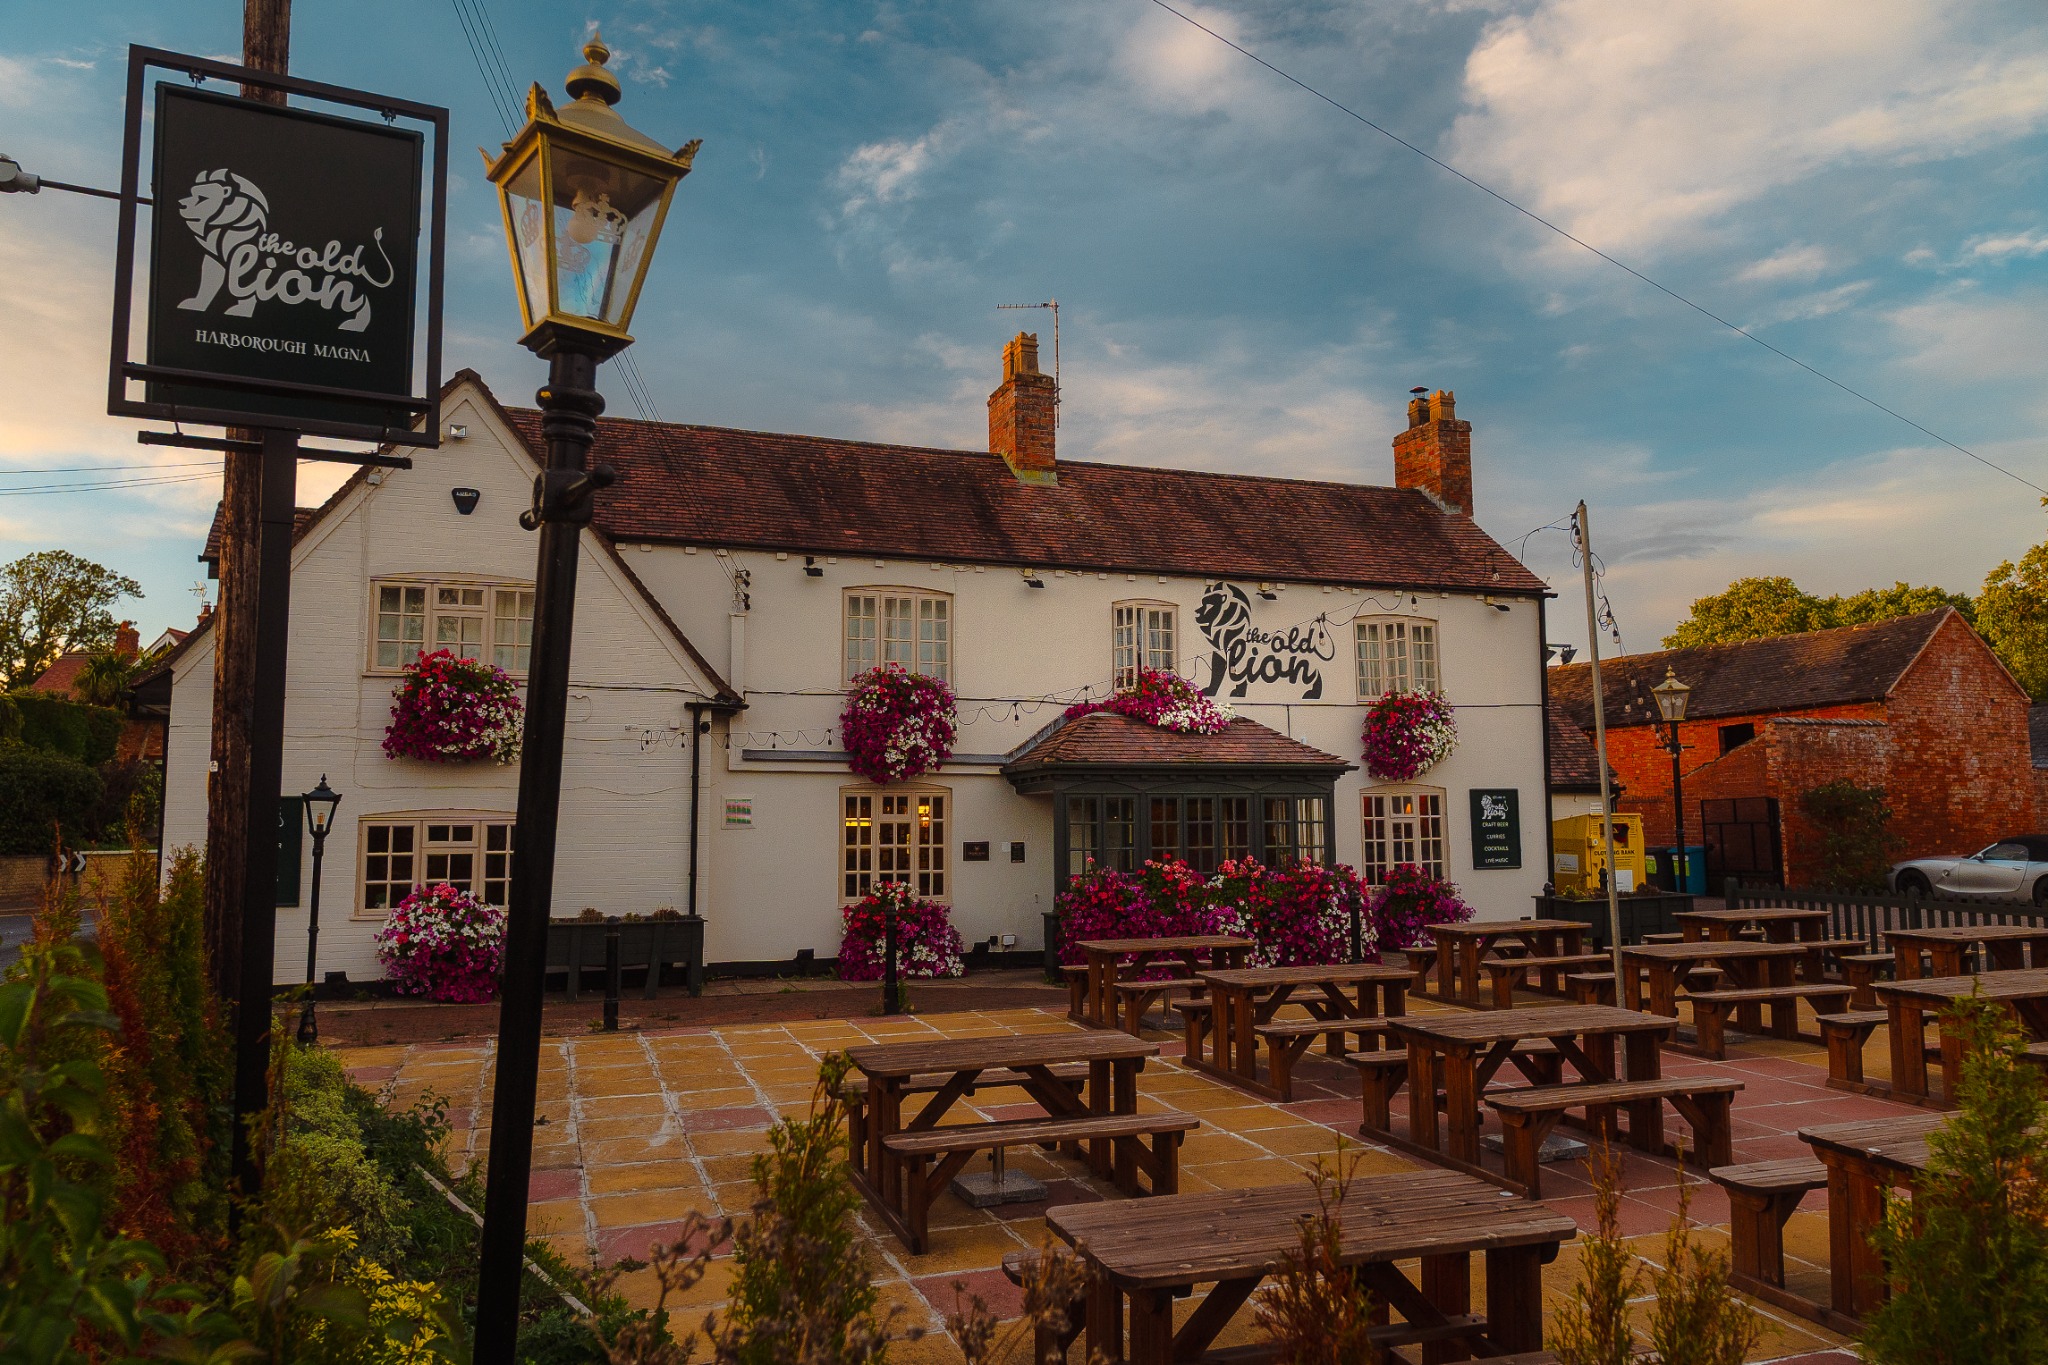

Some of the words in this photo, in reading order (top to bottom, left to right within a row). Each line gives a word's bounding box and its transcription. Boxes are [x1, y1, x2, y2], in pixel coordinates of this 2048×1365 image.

[258, 232, 297, 255] the
[296, 240, 367, 275] old
[228, 244, 365, 313] lion
[195, 329, 307, 355] HARBOROUGH
[313, 343, 371, 363] MAGNA
[1229, 638, 1317, 685] lion
[1246, 627, 1272, 644] the
[1271, 627, 1316, 654] old
